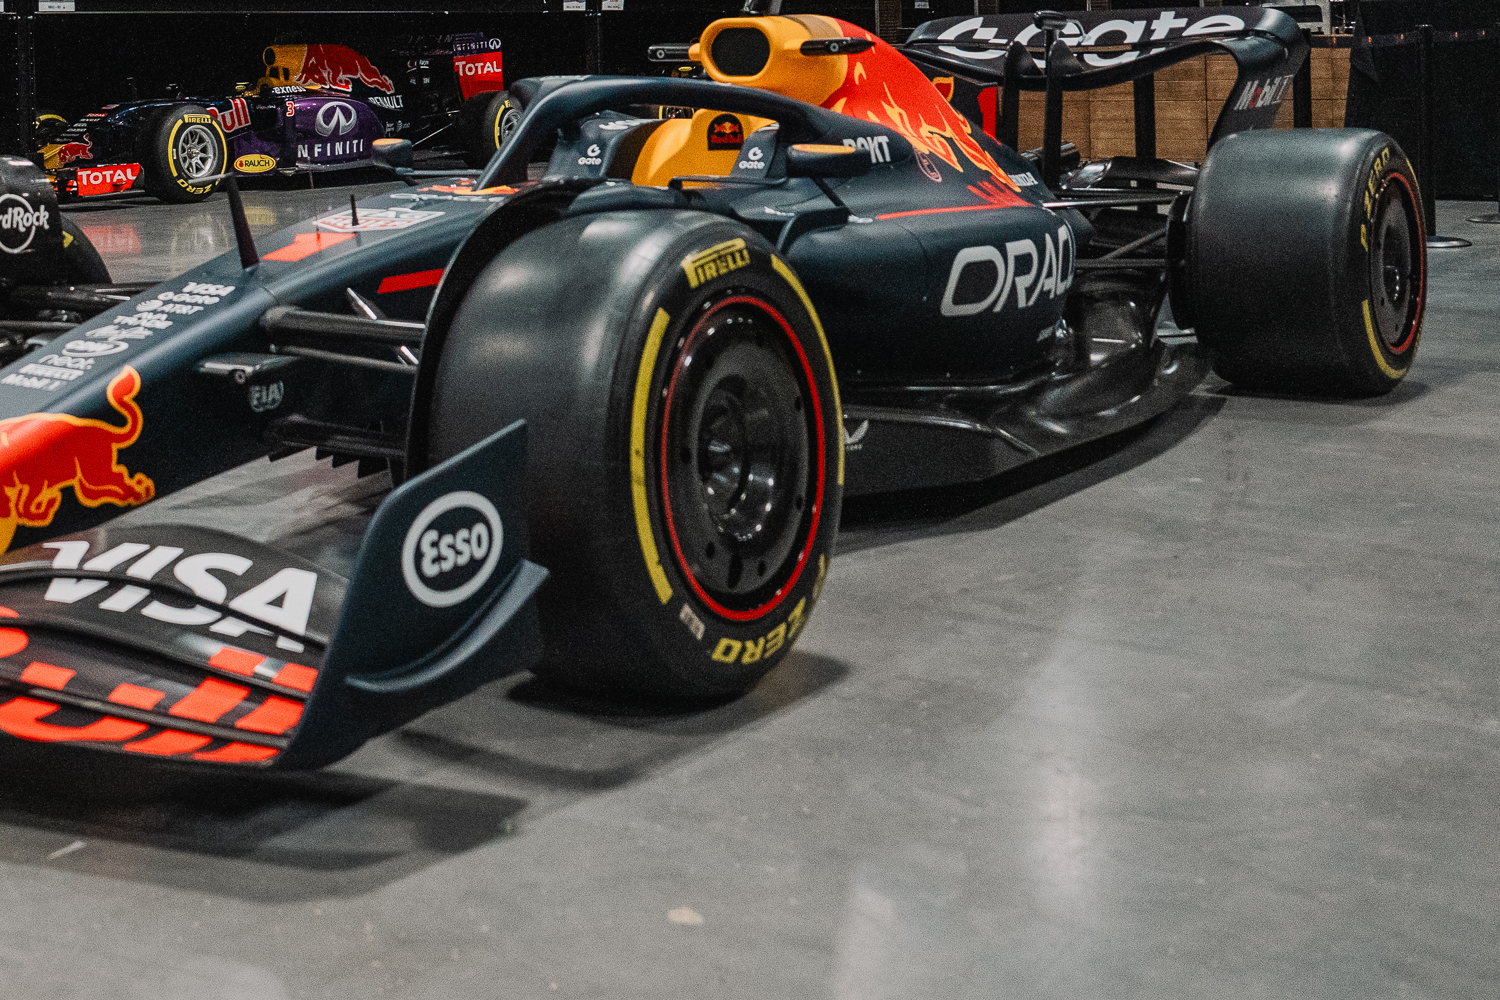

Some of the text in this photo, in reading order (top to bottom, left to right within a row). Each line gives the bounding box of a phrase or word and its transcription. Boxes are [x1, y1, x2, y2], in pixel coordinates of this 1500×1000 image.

[455, 59, 503, 76] TOTAL
[285, 101, 295, 117] 3
[184, 113, 212, 124] PIRELLI
[296, 138, 365, 158] NFINITI
[244, 159, 271, 168] RAUCH
[577, 156, 602, 166] Gate
[738, 160, 766, 170] Gate
[77, 167, 140, 186] TOTAL
[680, 236, 751, 289] PIRELLI
[940, 217, 1075, 318] ORAC
[41, 539, 319, 653] VISA
